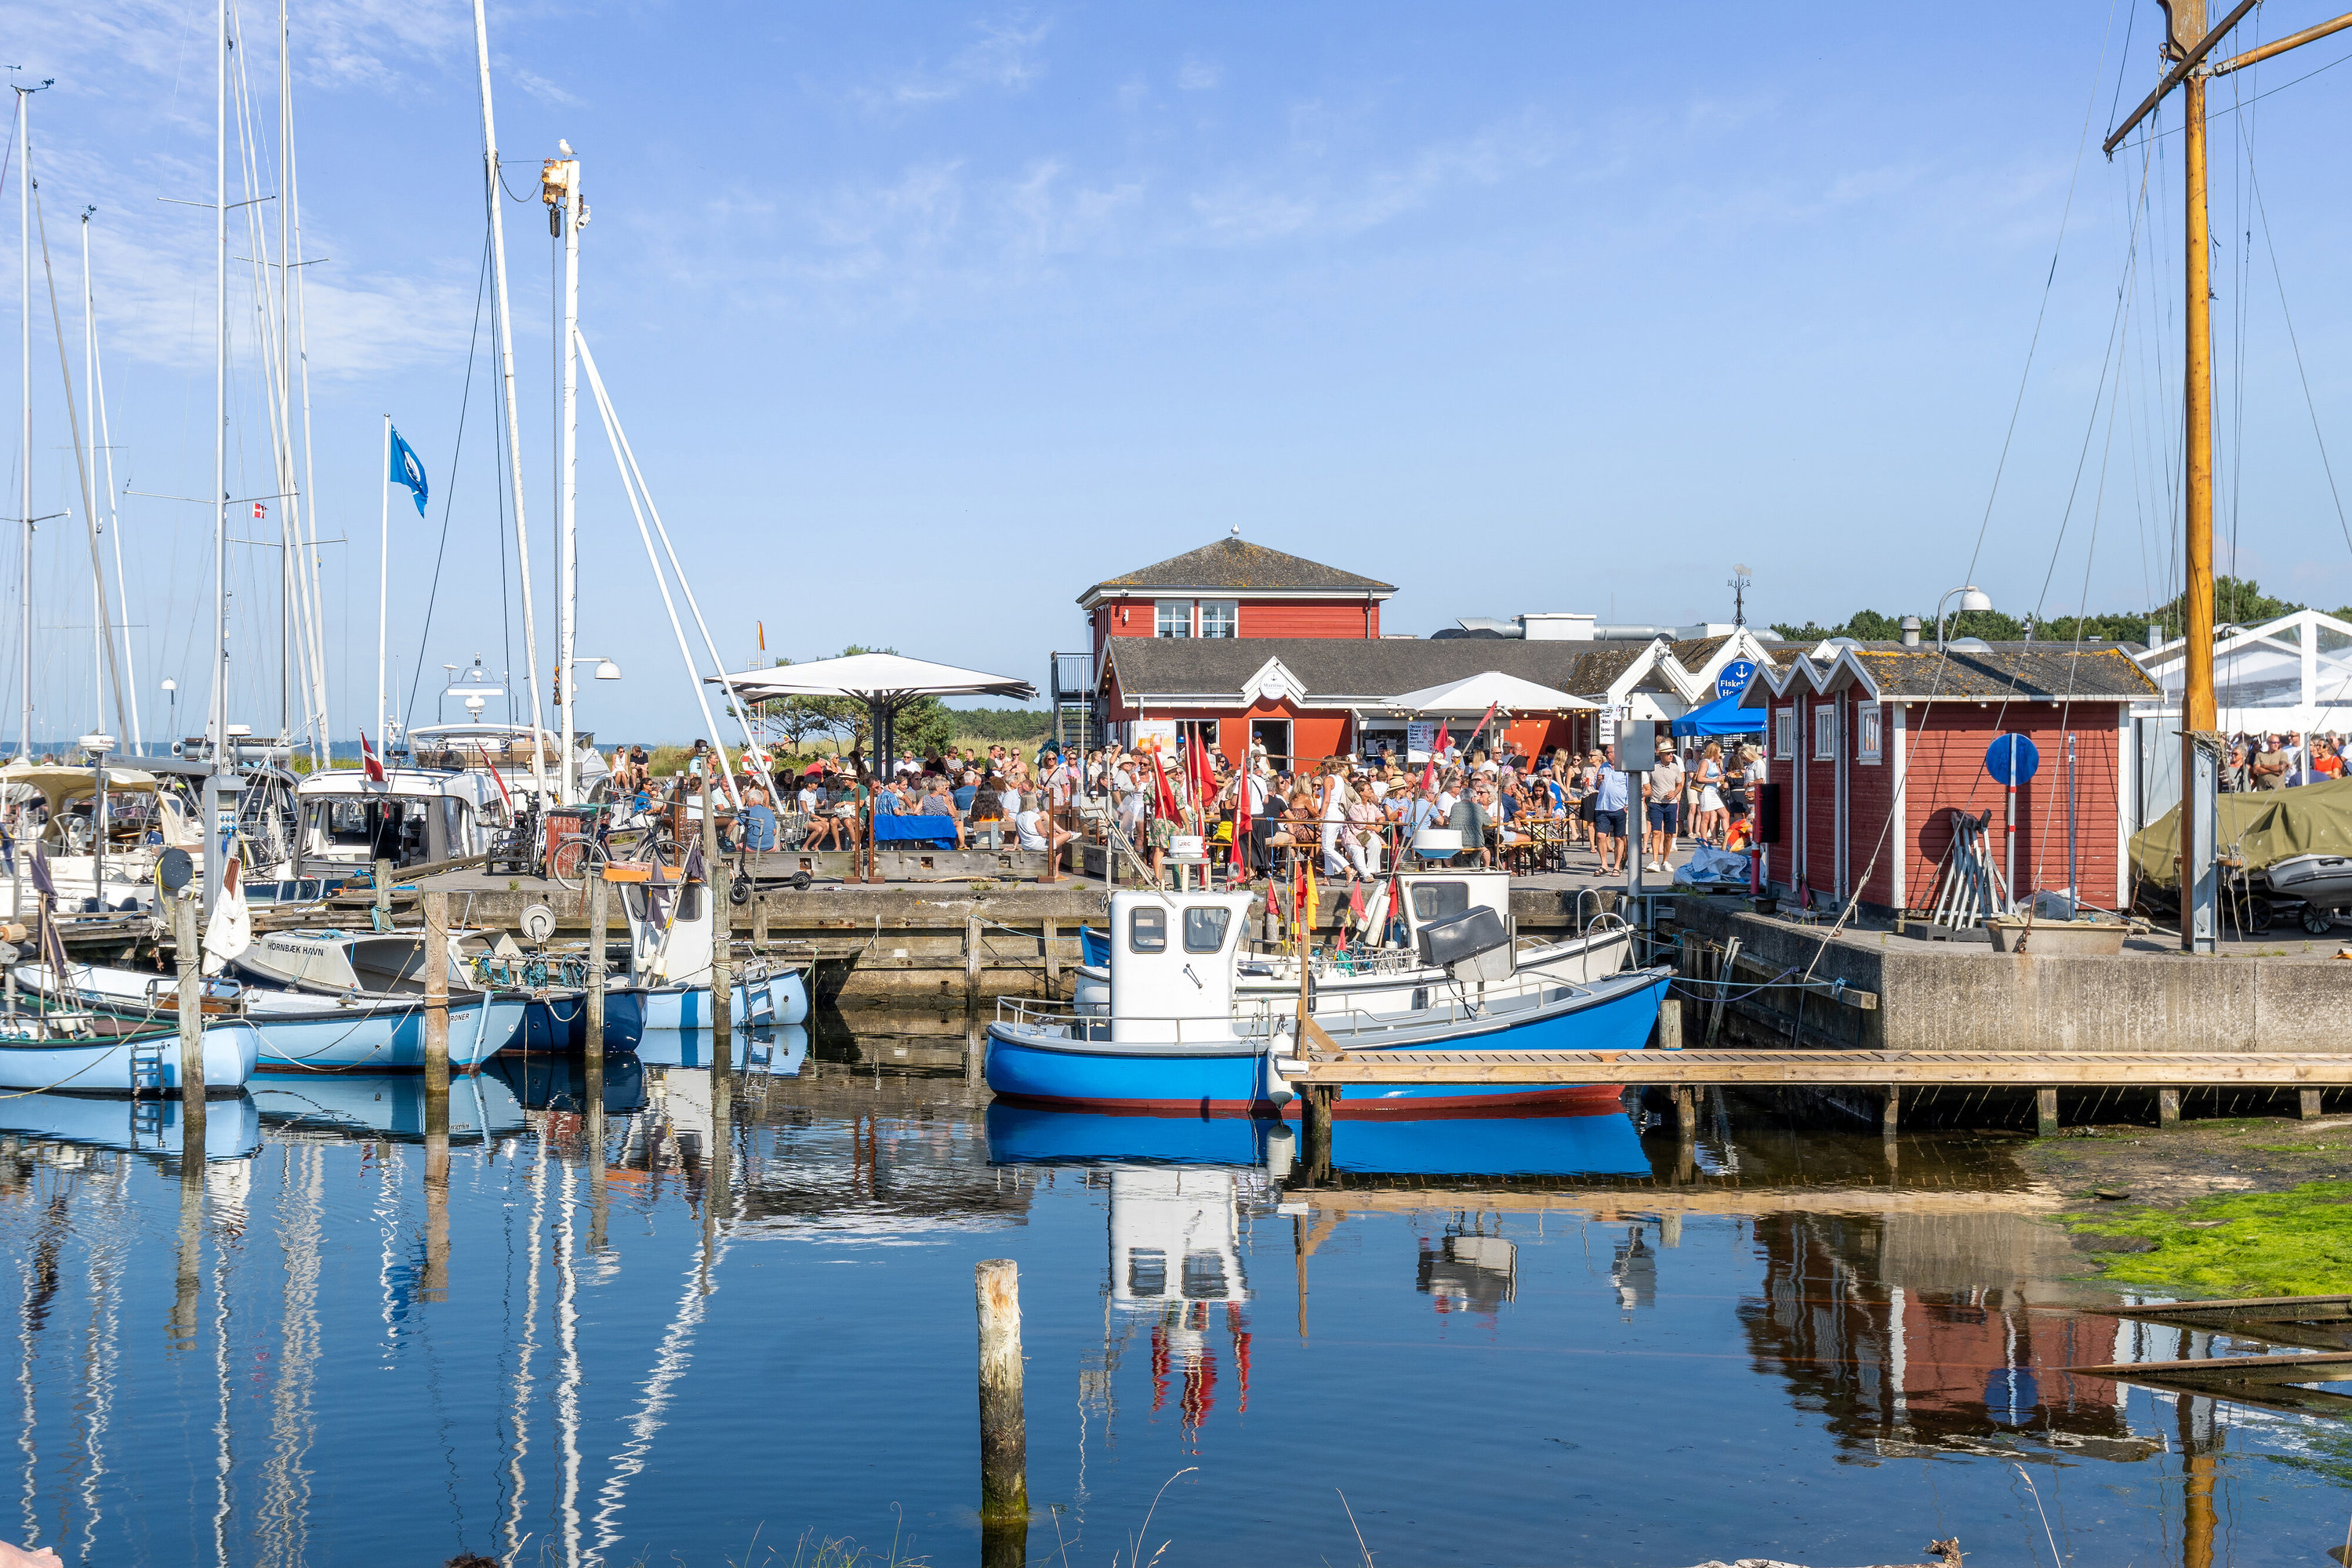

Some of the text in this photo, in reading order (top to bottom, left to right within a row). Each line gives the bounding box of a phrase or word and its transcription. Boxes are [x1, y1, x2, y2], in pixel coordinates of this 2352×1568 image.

[267, 942, 324, 956] HORNBÆK HAVN
[449, 1013, 470, 1022] RONER
